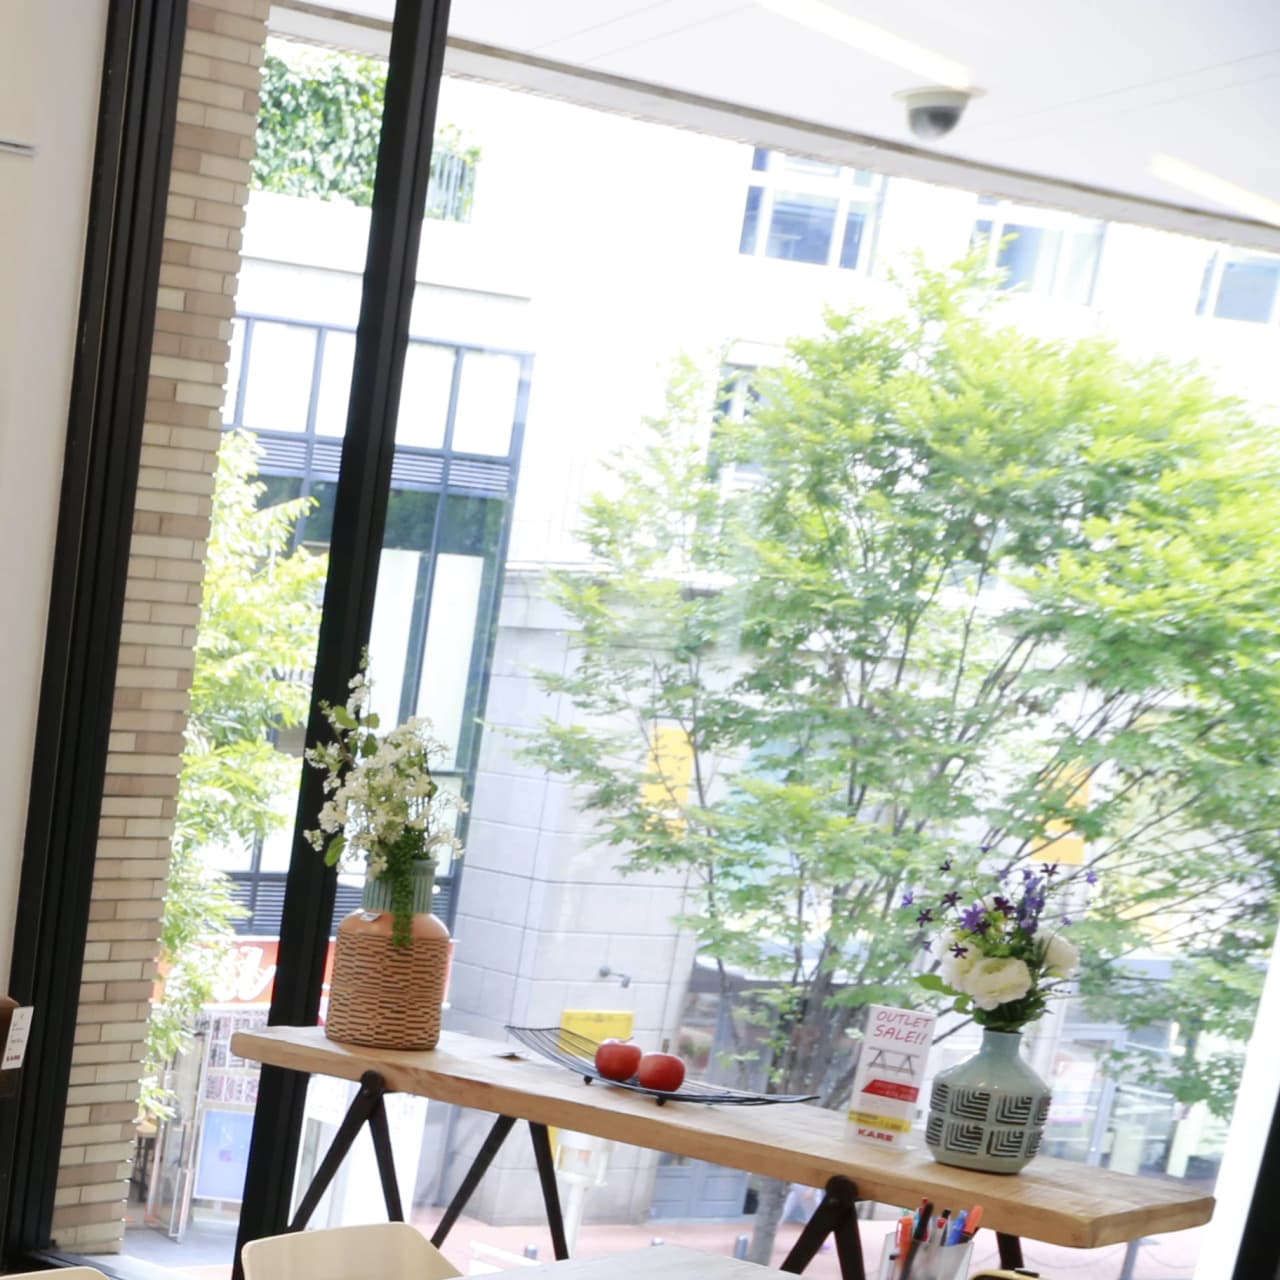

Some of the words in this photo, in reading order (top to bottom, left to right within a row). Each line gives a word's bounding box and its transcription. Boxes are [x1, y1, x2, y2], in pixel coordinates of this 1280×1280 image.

[876, 1010, 934, 1028] OUTLET
[873, 1024, 928, 1046] SALE!!
[857, 1127, 894, 1143] KARE
